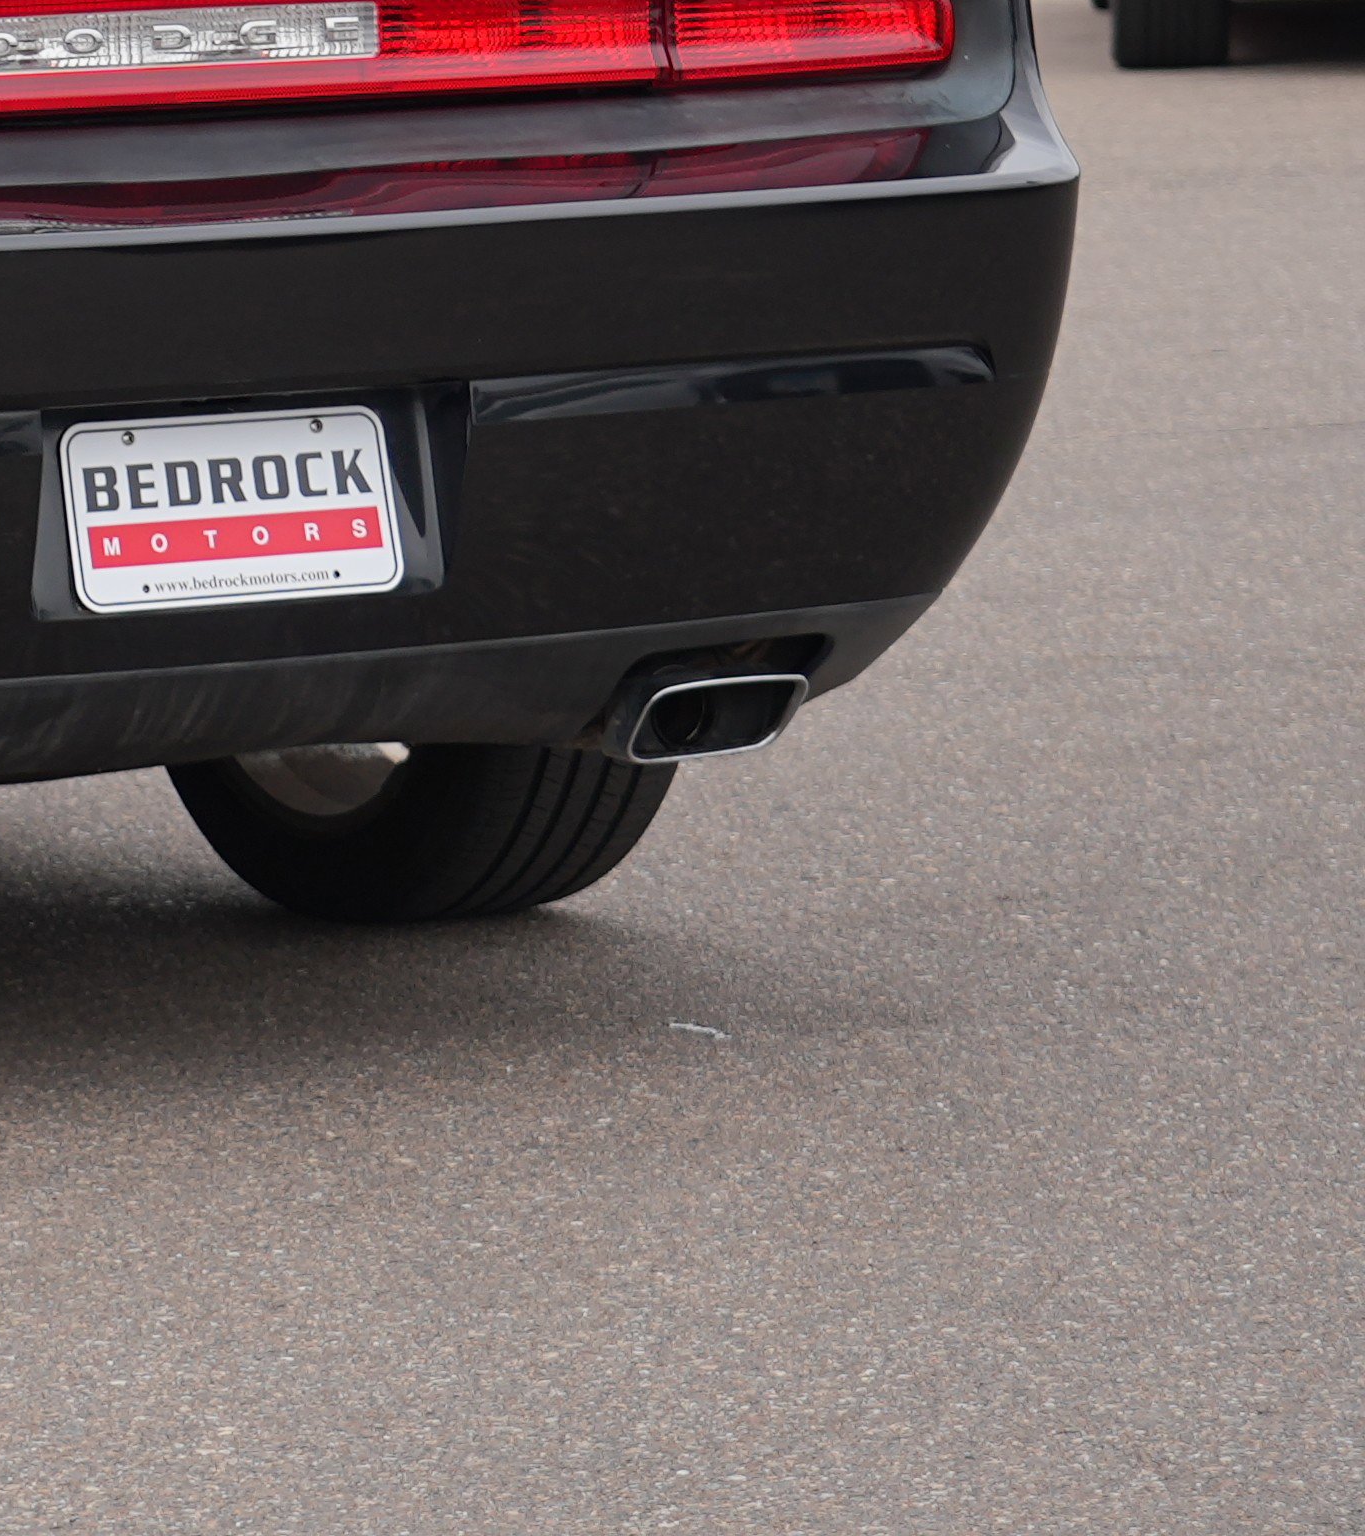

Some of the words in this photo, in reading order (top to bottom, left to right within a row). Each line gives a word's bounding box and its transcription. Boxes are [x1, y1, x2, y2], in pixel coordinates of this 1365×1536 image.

[82, 448, 373, 513] BEDROCK
[102, 518, 368, 556] MOTORS
[154, 569, 330, 594] www.bedrockmotors.com
